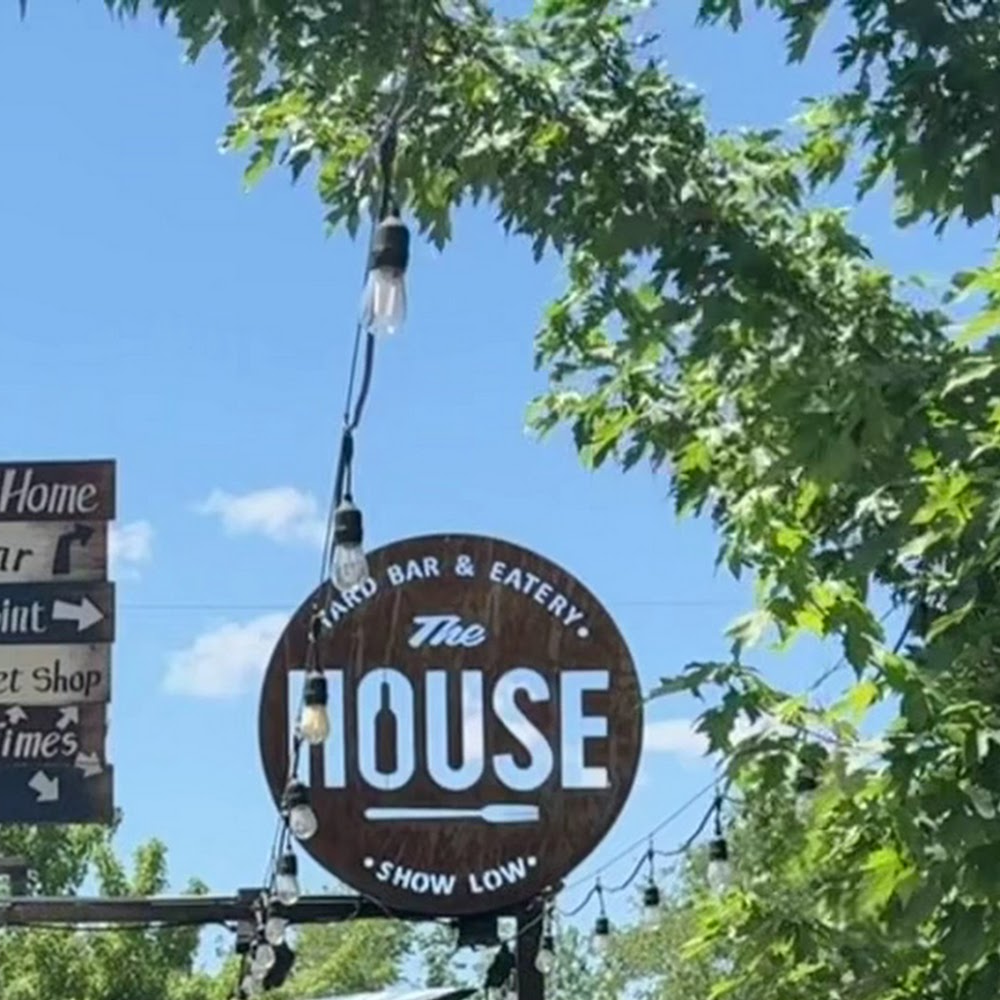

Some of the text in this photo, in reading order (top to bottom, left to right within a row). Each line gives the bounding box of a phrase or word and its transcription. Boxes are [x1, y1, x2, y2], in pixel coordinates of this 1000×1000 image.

[0, 468, 100, 514] Home
[387, 556, 440, 586] BAR
[455, 554, 475, 577] &
[489, 561, 584, 628] EATERY
[408, 613, 487, 648] The
[287, 667, 612, 792] HOUSE
[375, 858, 529, 895] SHOW LOW
